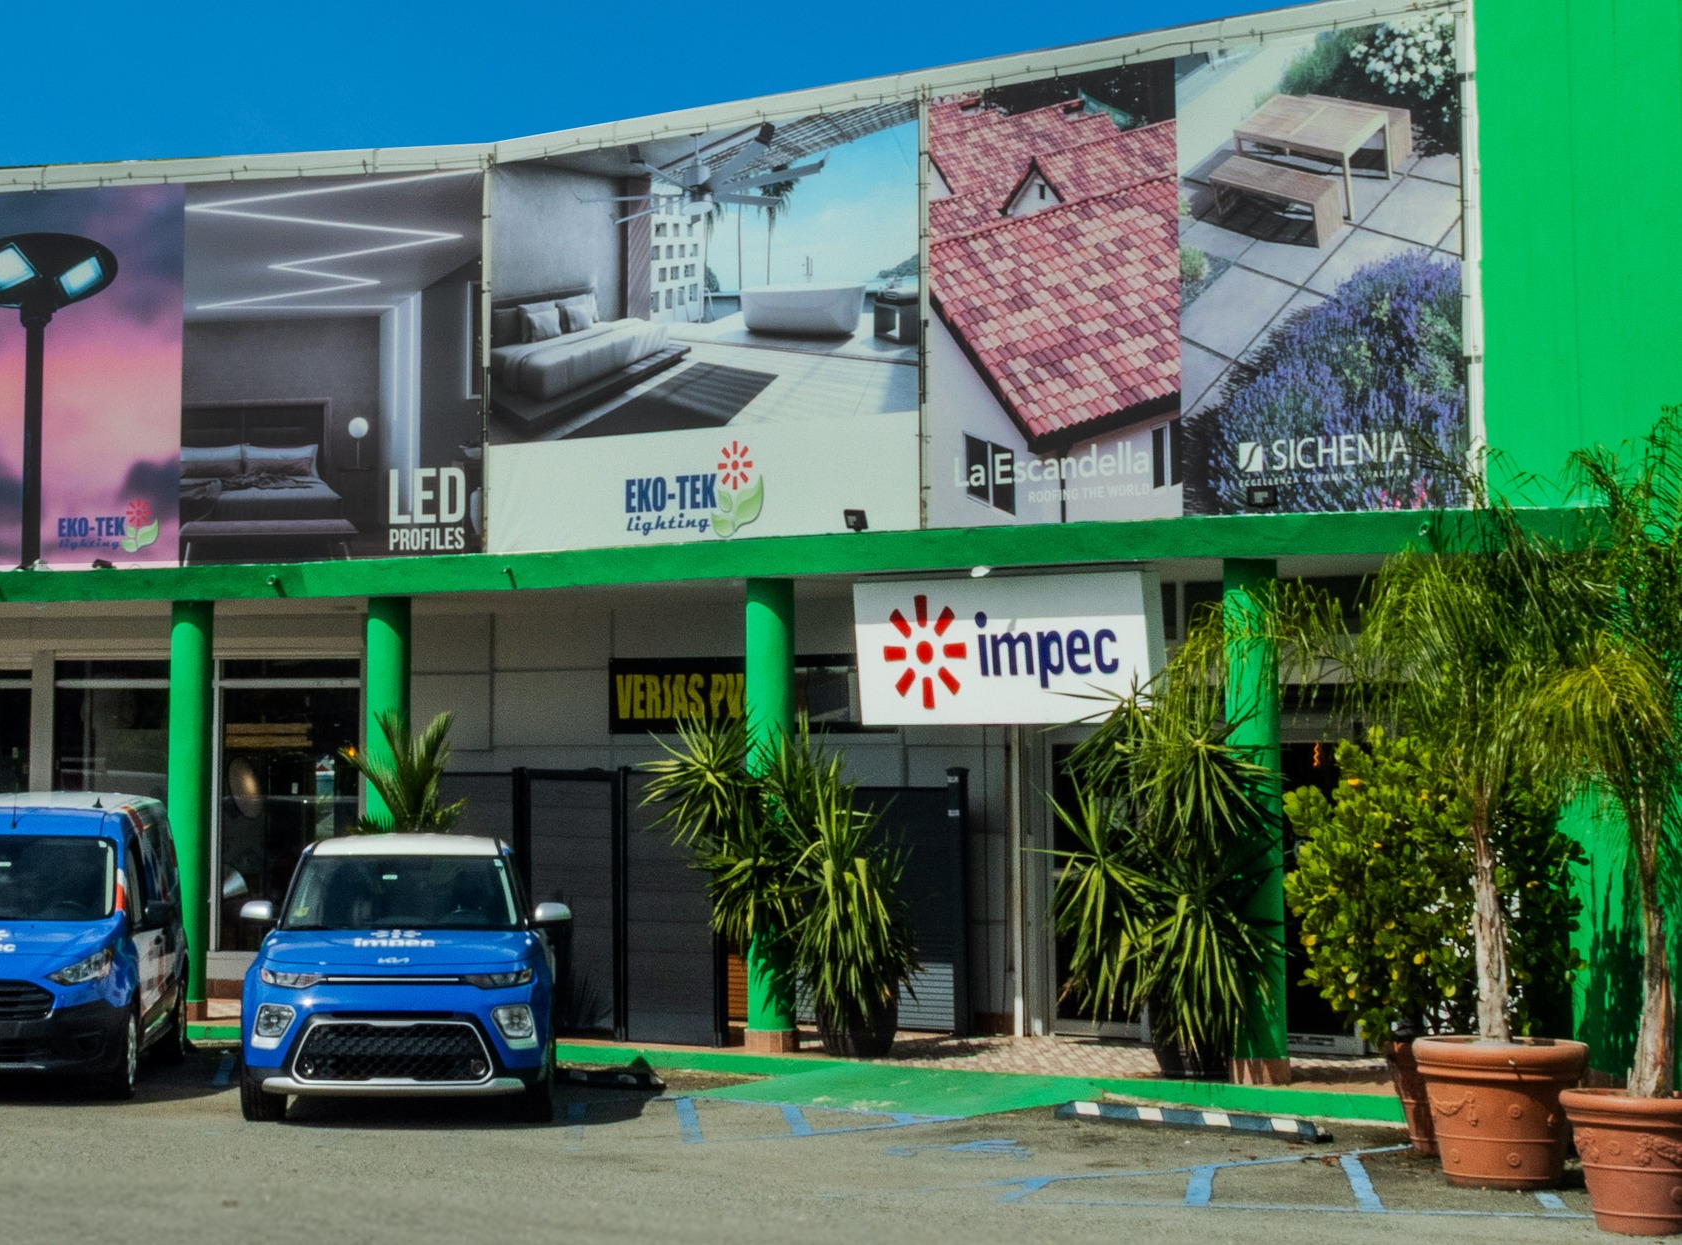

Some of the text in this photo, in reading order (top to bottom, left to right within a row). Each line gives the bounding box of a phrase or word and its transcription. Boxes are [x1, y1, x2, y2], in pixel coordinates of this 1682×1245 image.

[954, 441, 1150, 488] La Escandella
[1272, 430, 1409, 471] SICHENIA
[388, 466, 466, 525] LED
[625, 473, 717, 513] EKO-TEK
[1028, 483, 1150, 504] ROOFING THE WORLD
[58, 516, 126, 537] EKO-TEK
[388, 527, 465, 551] PROFILES
[627, 512, 710, 536] lighting
[58, 538, 120, 551] lighting
[974, 611, 1119, 689] impec
[616, 673, 746, 719] VERJAS PV
